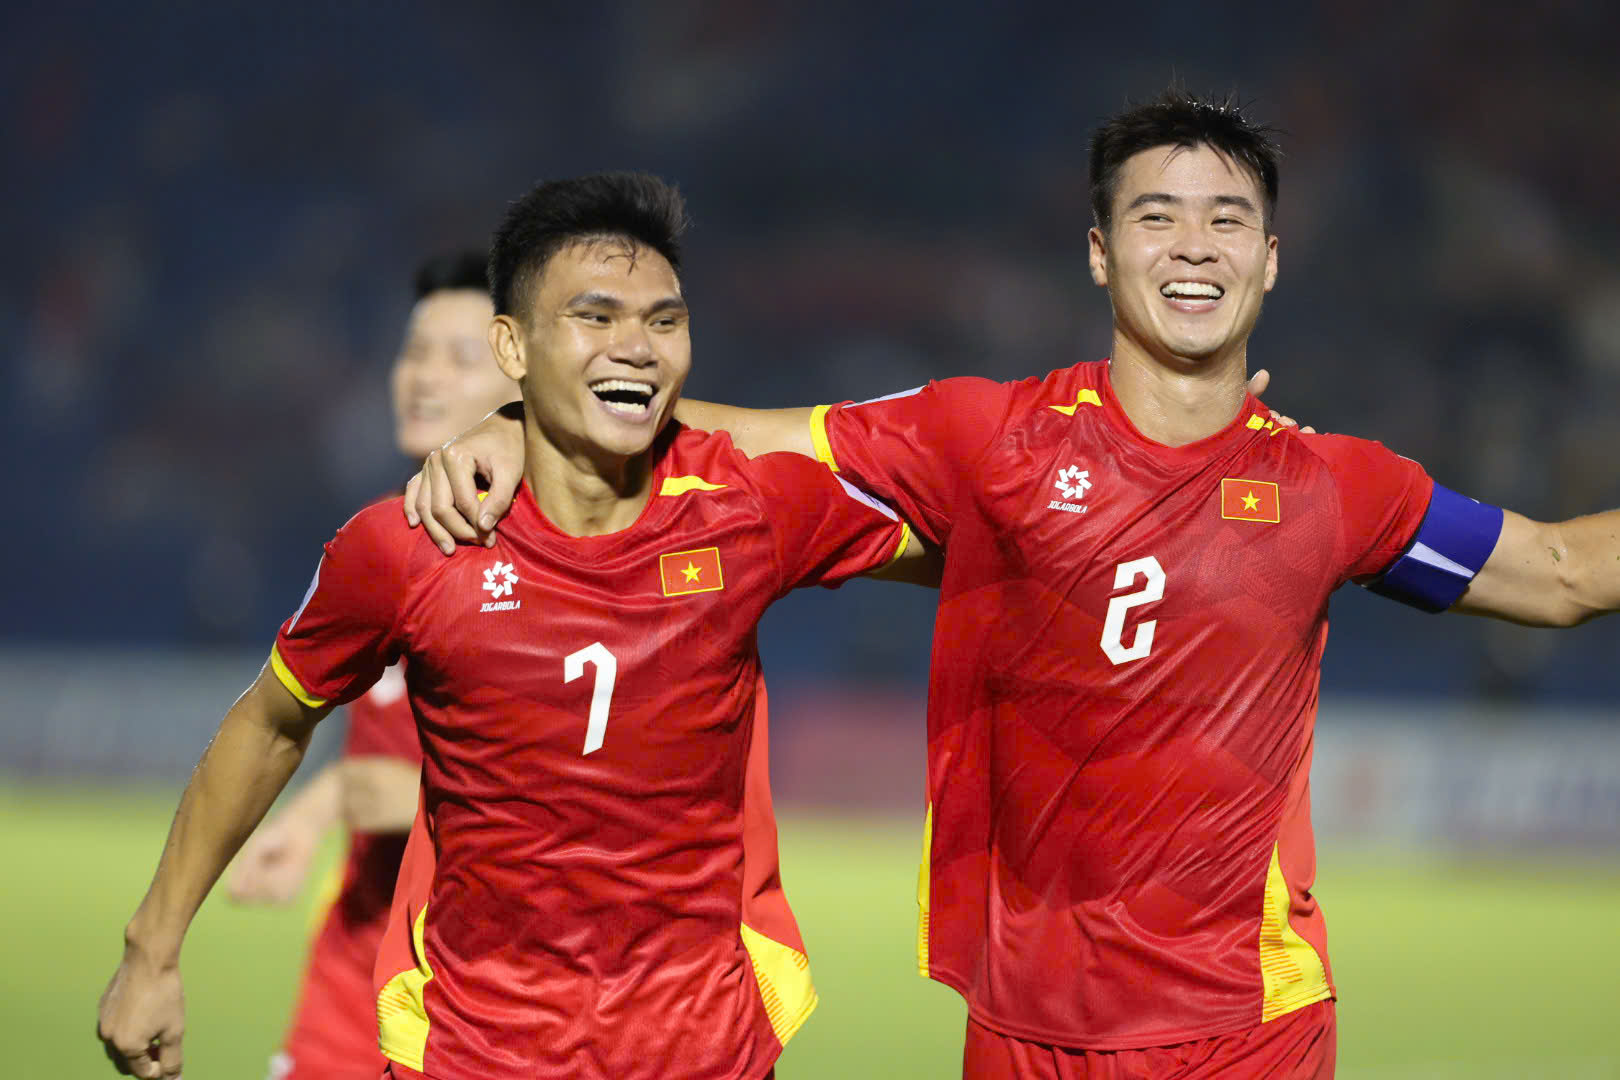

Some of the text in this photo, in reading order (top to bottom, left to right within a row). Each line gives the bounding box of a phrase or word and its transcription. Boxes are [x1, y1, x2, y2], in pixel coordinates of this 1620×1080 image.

[1047, 500, 1088, 514] JOGARBOLA
[480, 600, 520, 612] JOGARBOLA
[1100, 556, 1166, 665] 2
[564, 641, 617, 756] 7
